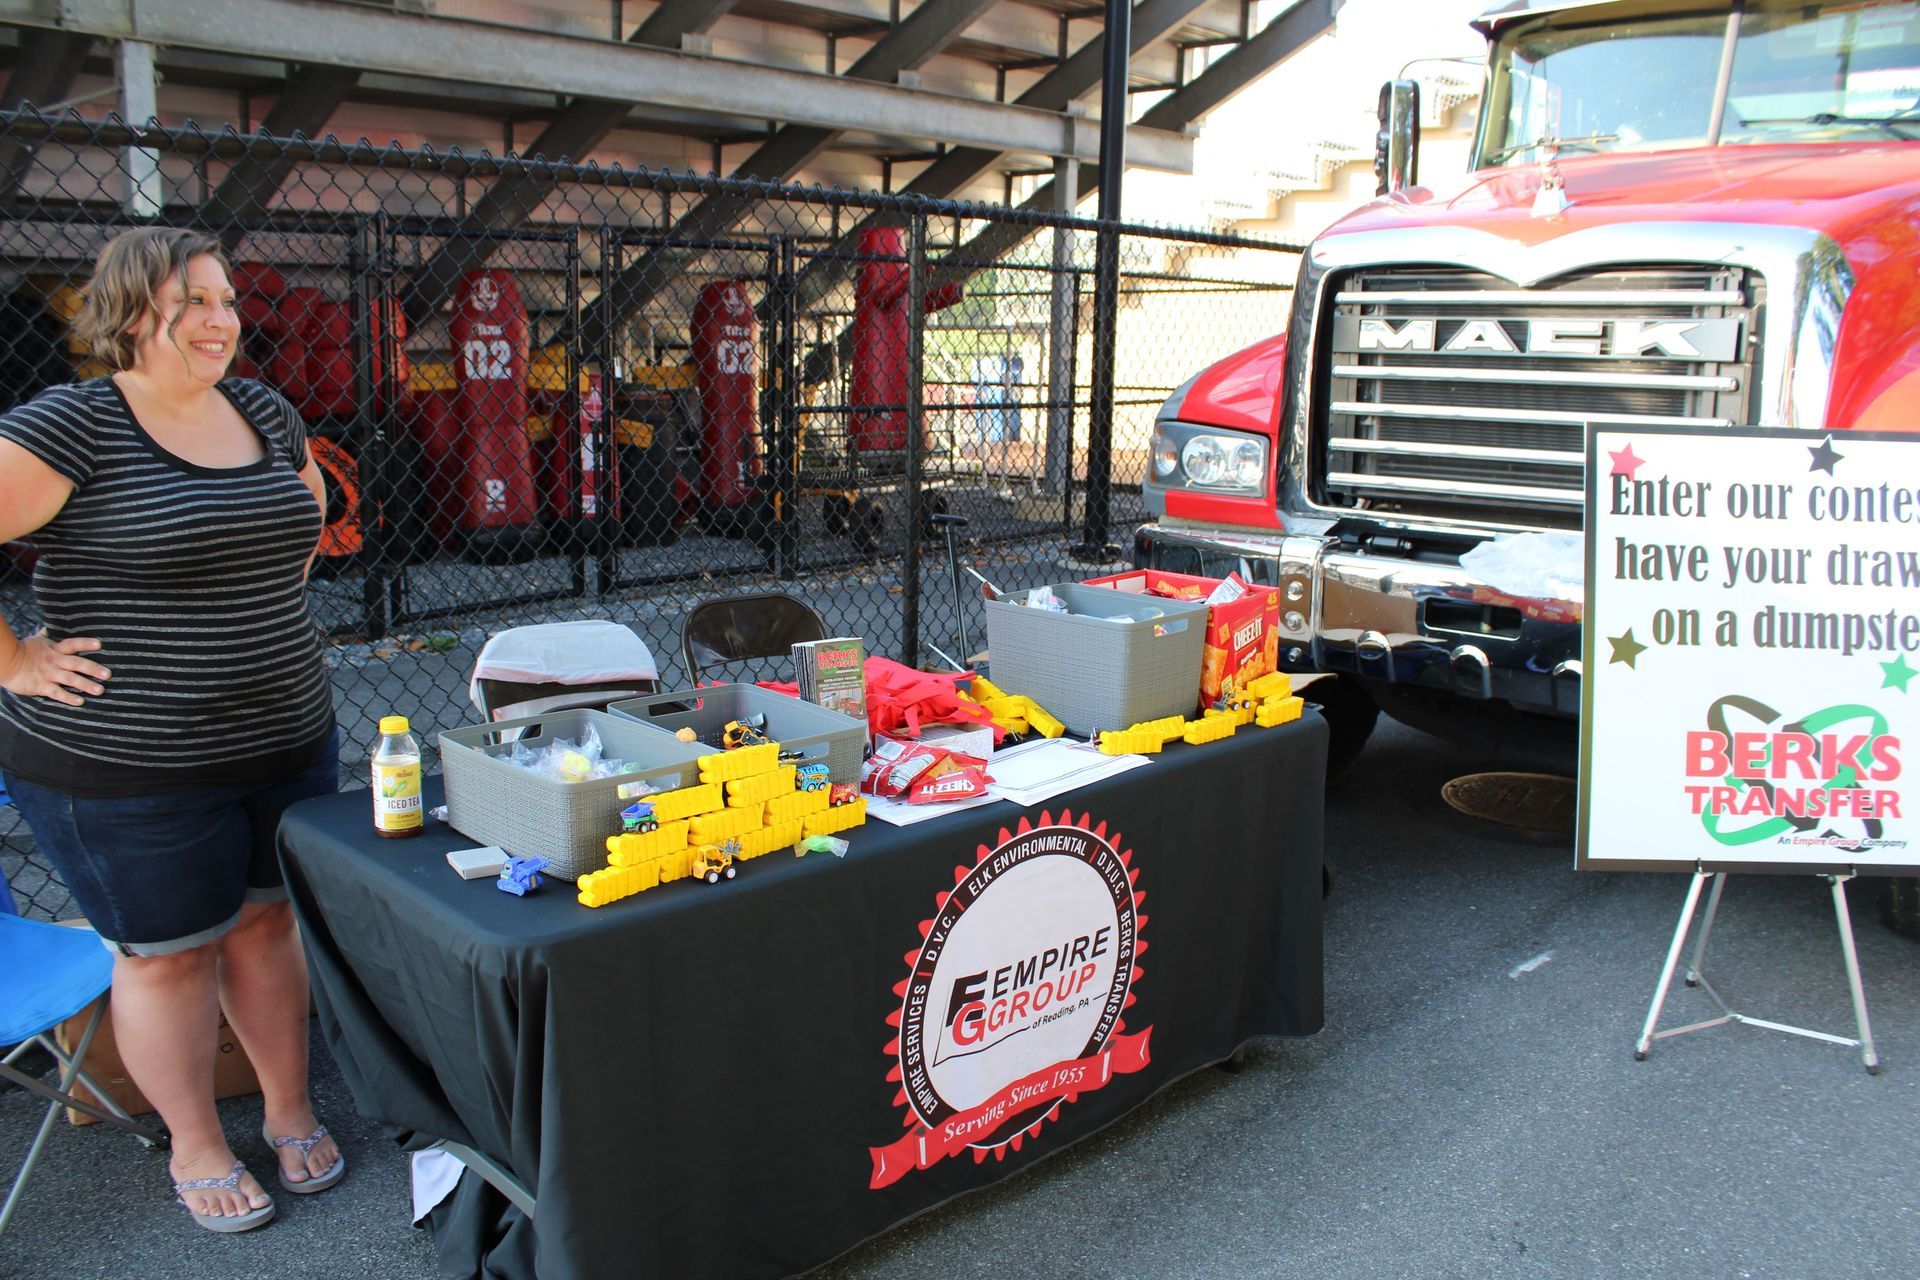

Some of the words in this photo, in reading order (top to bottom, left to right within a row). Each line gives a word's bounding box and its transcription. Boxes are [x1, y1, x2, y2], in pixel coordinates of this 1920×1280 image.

[1358, 317, 1706, 358] MACK
[1610, 472, 1712, 518] Enter
[1727, 482, 1793, 519] our
[1615, 536, 1709, 582] have
[1722, 545, 1812, 589] your
[1652, 608, 1701, 646] on
[1715, 609, 1738, 647] a
[1685, 730, 1903, 782] BERKS
[388, 800, 407, 809] ICED
[1684, 785, 1903, 819] TRANSFER
[968, 866, 993, 897] ELK
[993, 835, 1087, 875] ENVIRONMENTAL
[1777, 836, 1791, 845] An
[1792, 836, 1827, 846] Empire
[1829, 837, 1859, 848] Group
[1860, 837, 1909, 849] Company
[1096, 851, 1125, 899] D.V.U.C.
[925, 915, 956, 962] D.V.C.
[1120, 909, 1132, 960] BERKS
[992, 925, 1111, 1000] EMPIRE
[987, 962, 1097, 1033] GROUP
[1032, 1018, 1042, 1030] of
[1078, 998, 1089, 1008] PA
[1093, 962, 1129, 1042] TRANSFER
[906, 984, 927, 1066] SERVICES
[909, 1065, 939, 1115] EMPIRE
[943, 1100, 1007, 1143] Serving
[1008, 1079, 1049, 1107] Since
[1051, 1066, 1087, 1089] 1955
